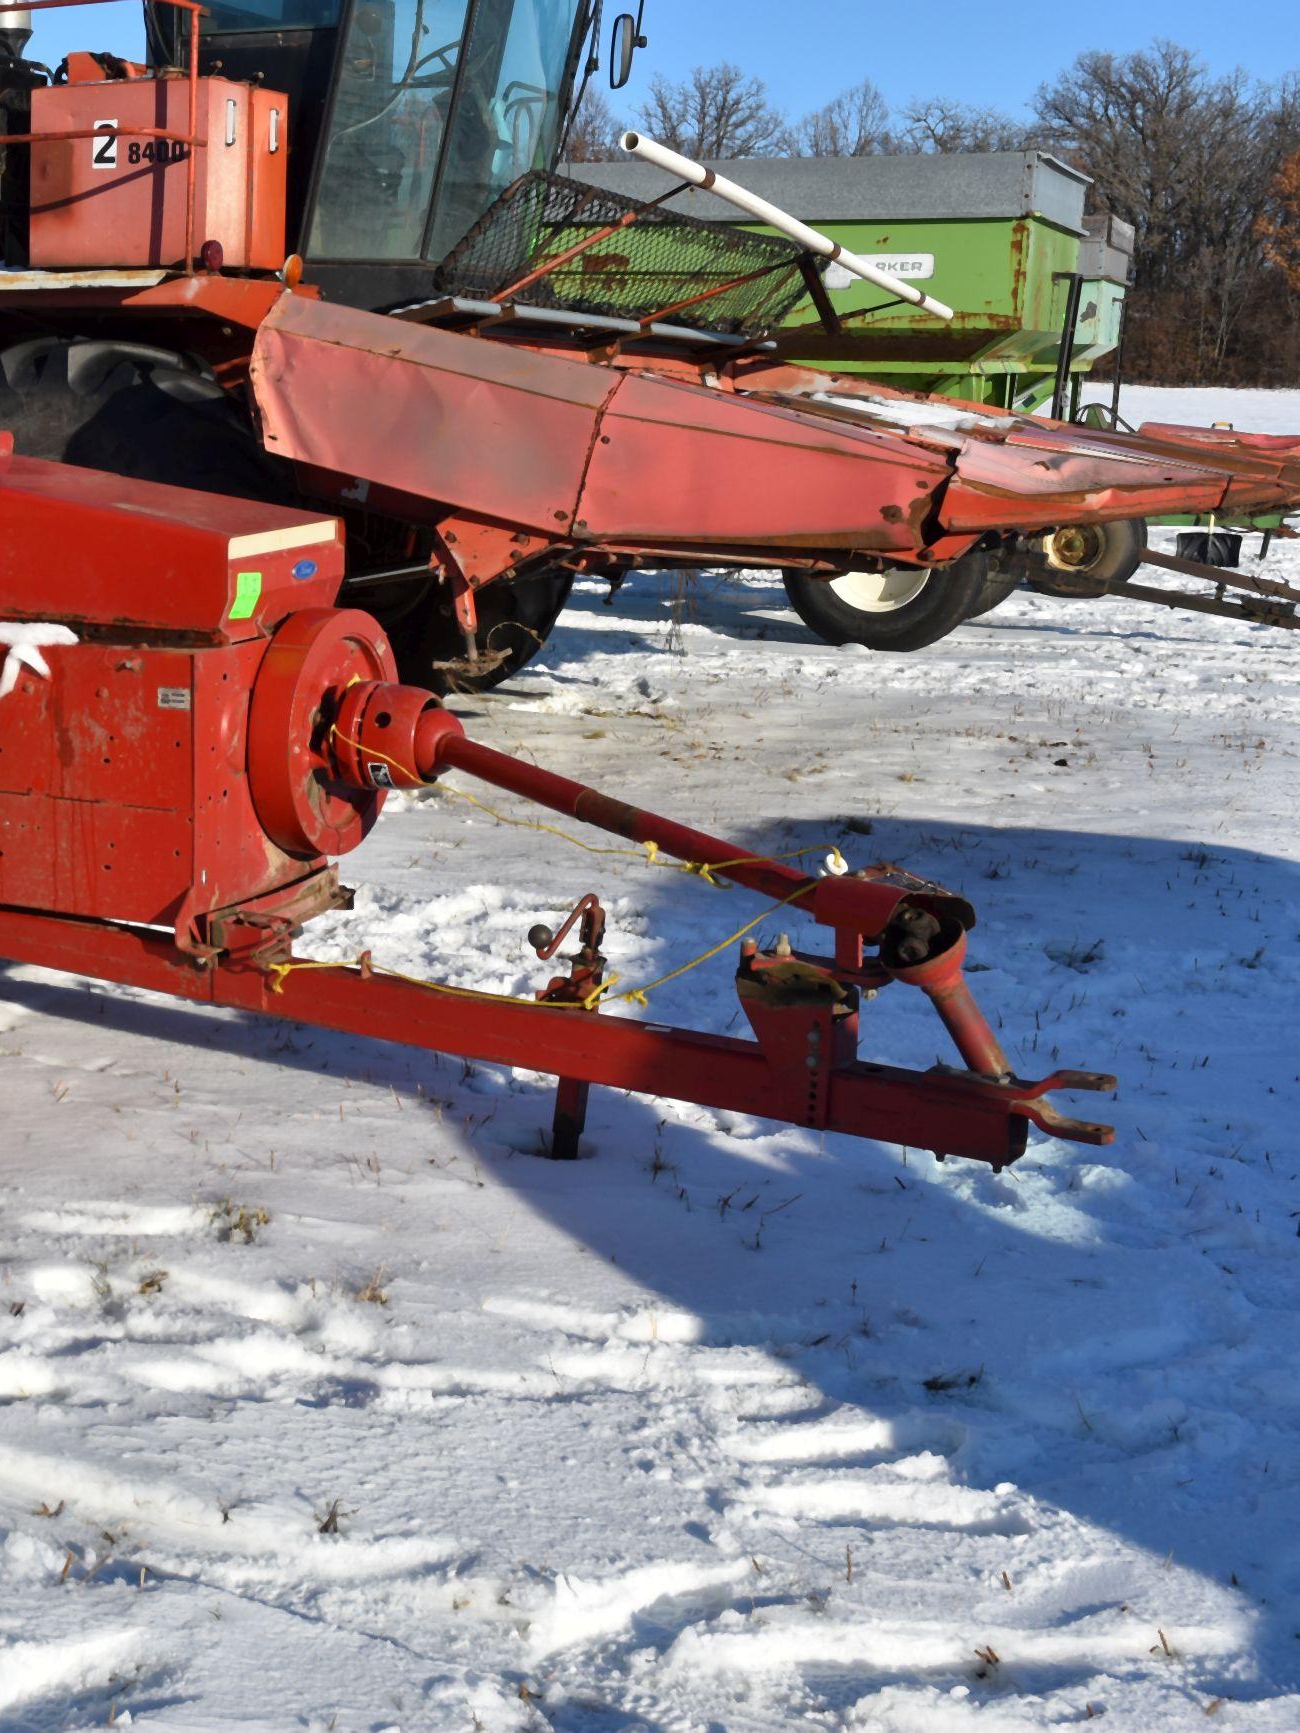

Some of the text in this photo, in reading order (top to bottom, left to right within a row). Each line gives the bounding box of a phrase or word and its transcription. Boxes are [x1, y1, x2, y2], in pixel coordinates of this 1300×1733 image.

[94, 124, 116, 163] 2
[128, 140, 185, 164] 8400
[875, 261, 923, 272] RKER
